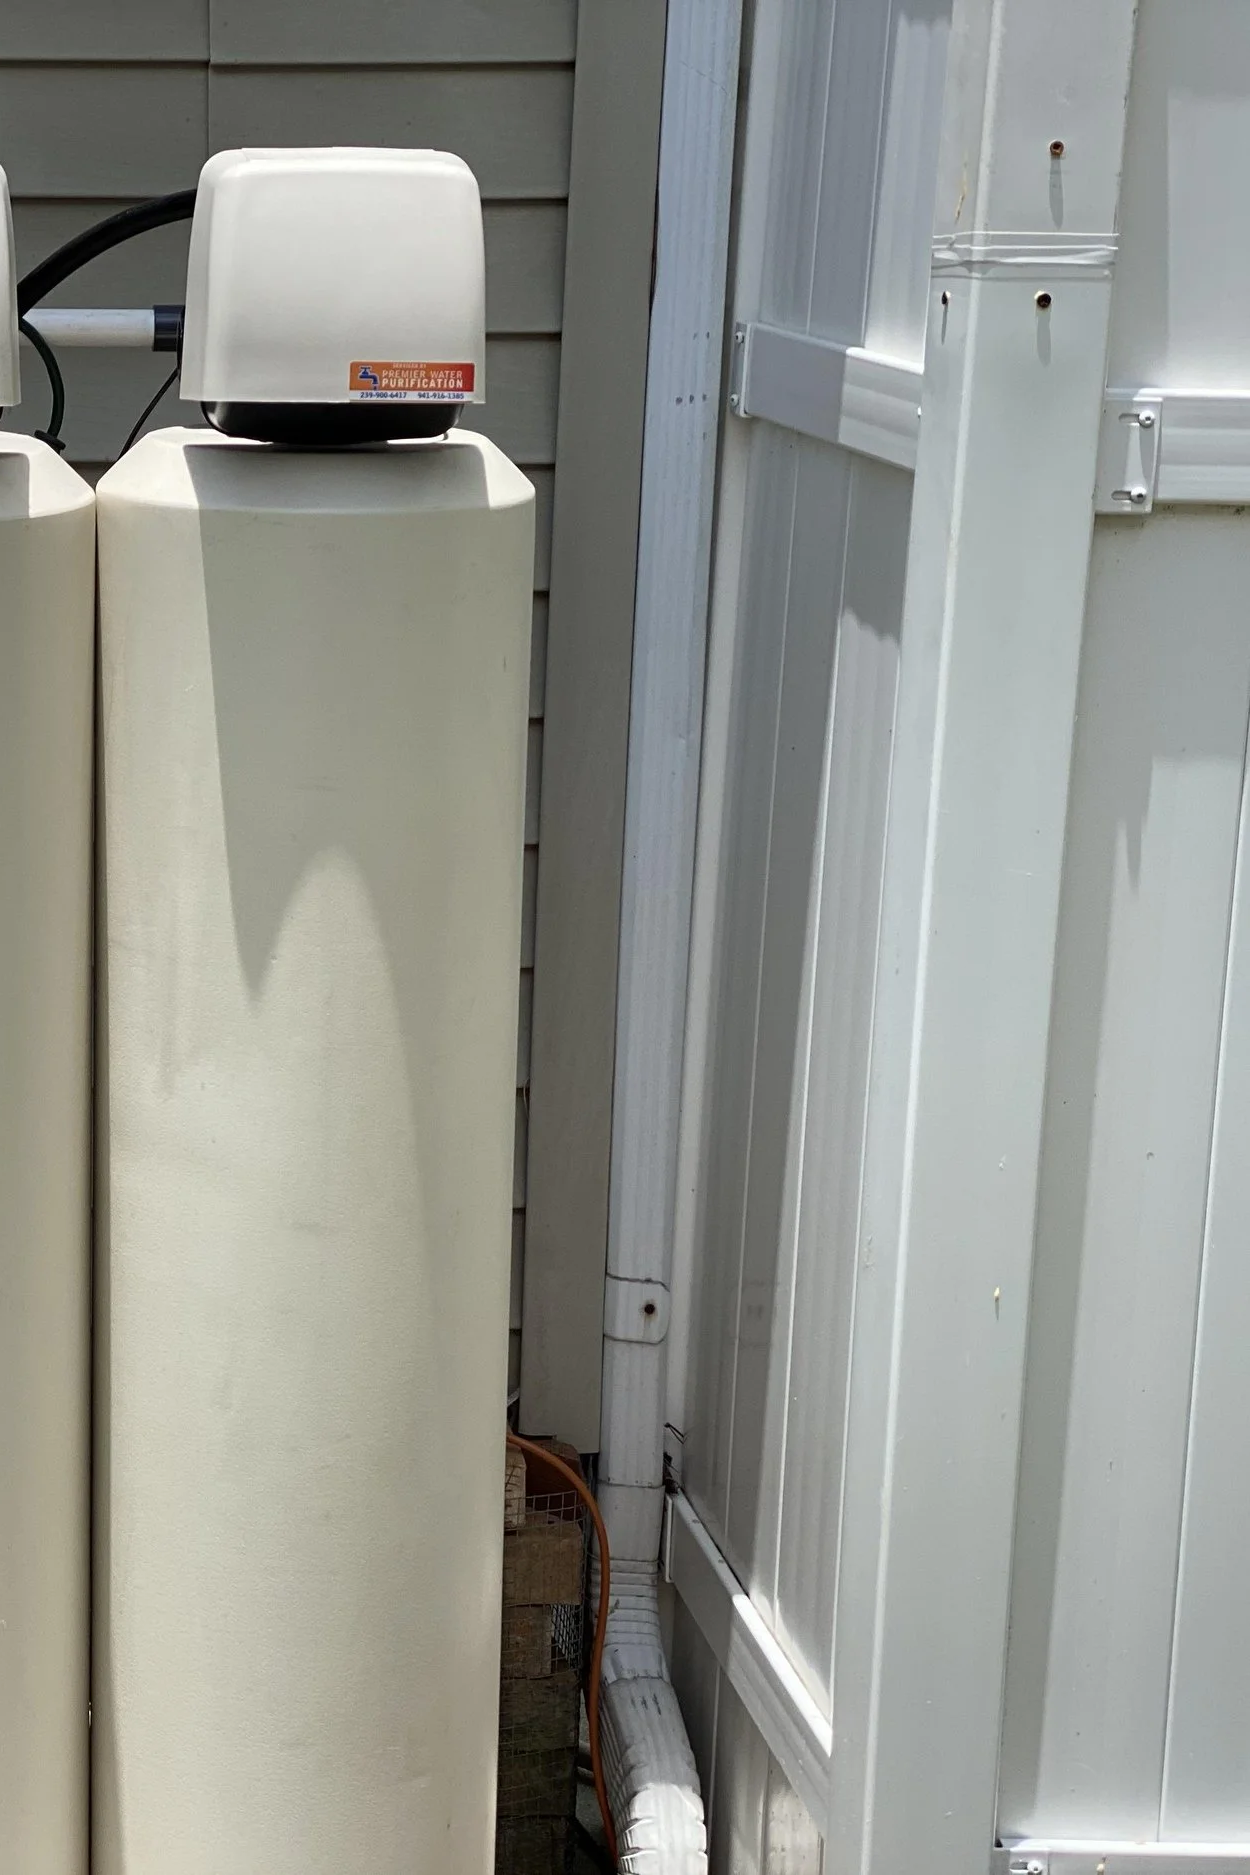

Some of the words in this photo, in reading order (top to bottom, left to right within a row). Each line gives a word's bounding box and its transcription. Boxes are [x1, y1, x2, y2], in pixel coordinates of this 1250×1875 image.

[382, 369, 426, 378] PREMIER
[430, 370, 463, 378] WATER
[381, 378, 463, 388] PURIFICATION
